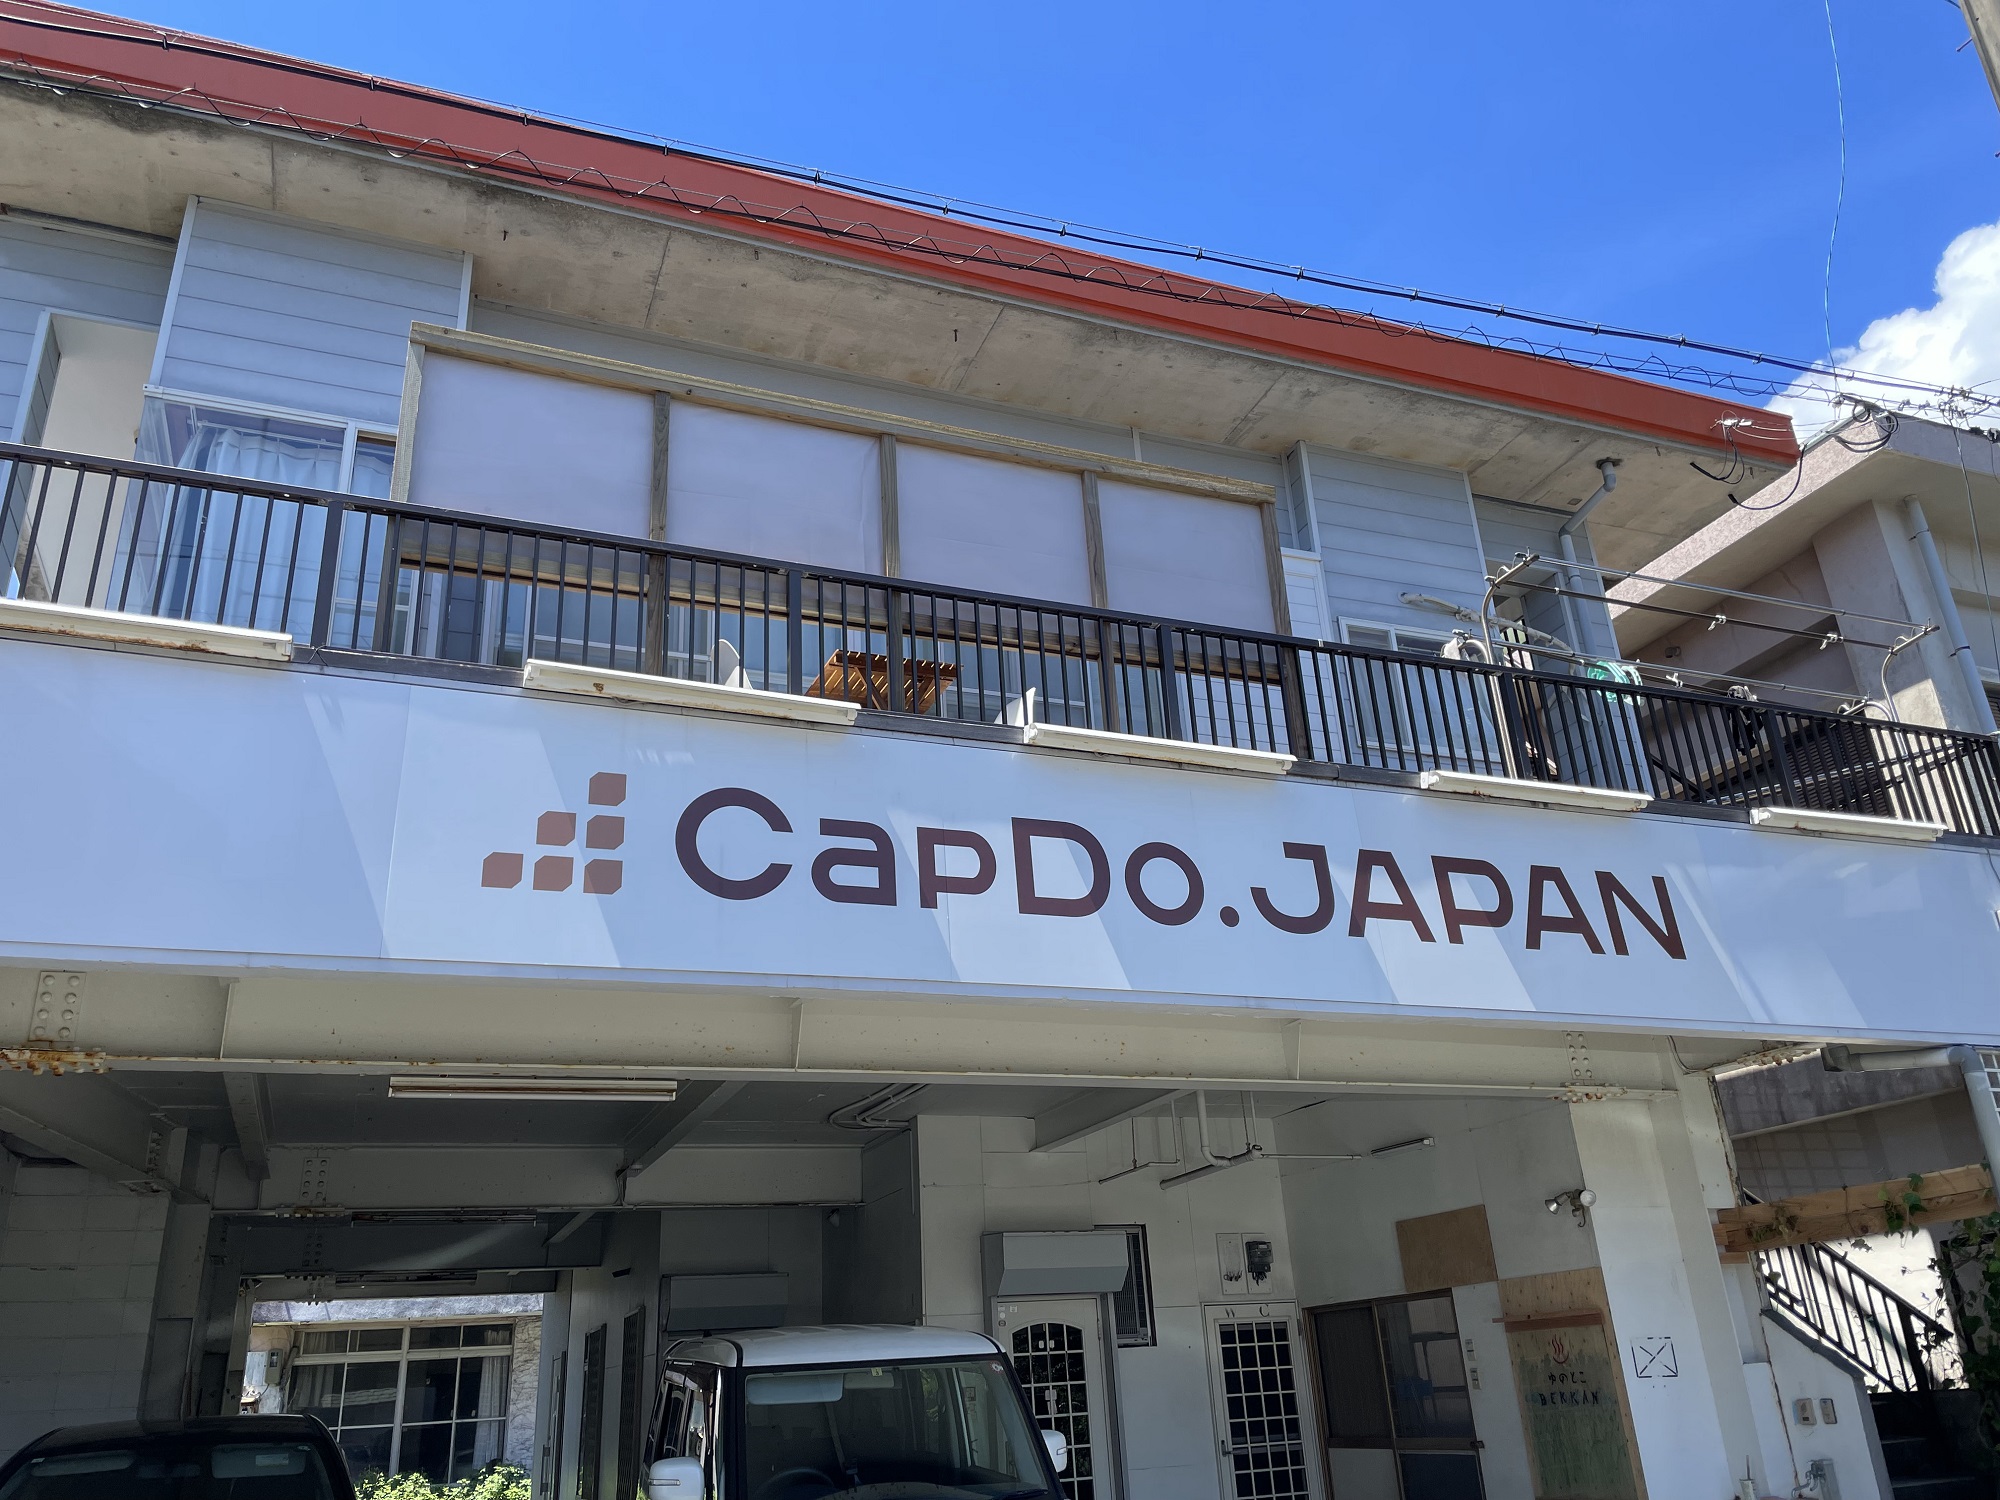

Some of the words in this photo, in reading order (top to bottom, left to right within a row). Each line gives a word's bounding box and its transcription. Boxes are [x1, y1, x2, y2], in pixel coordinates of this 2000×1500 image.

[1547, 1371, 1587, 1386] ゆのとこ
[1538, 1389, 1599, 1406] BEKKAN
